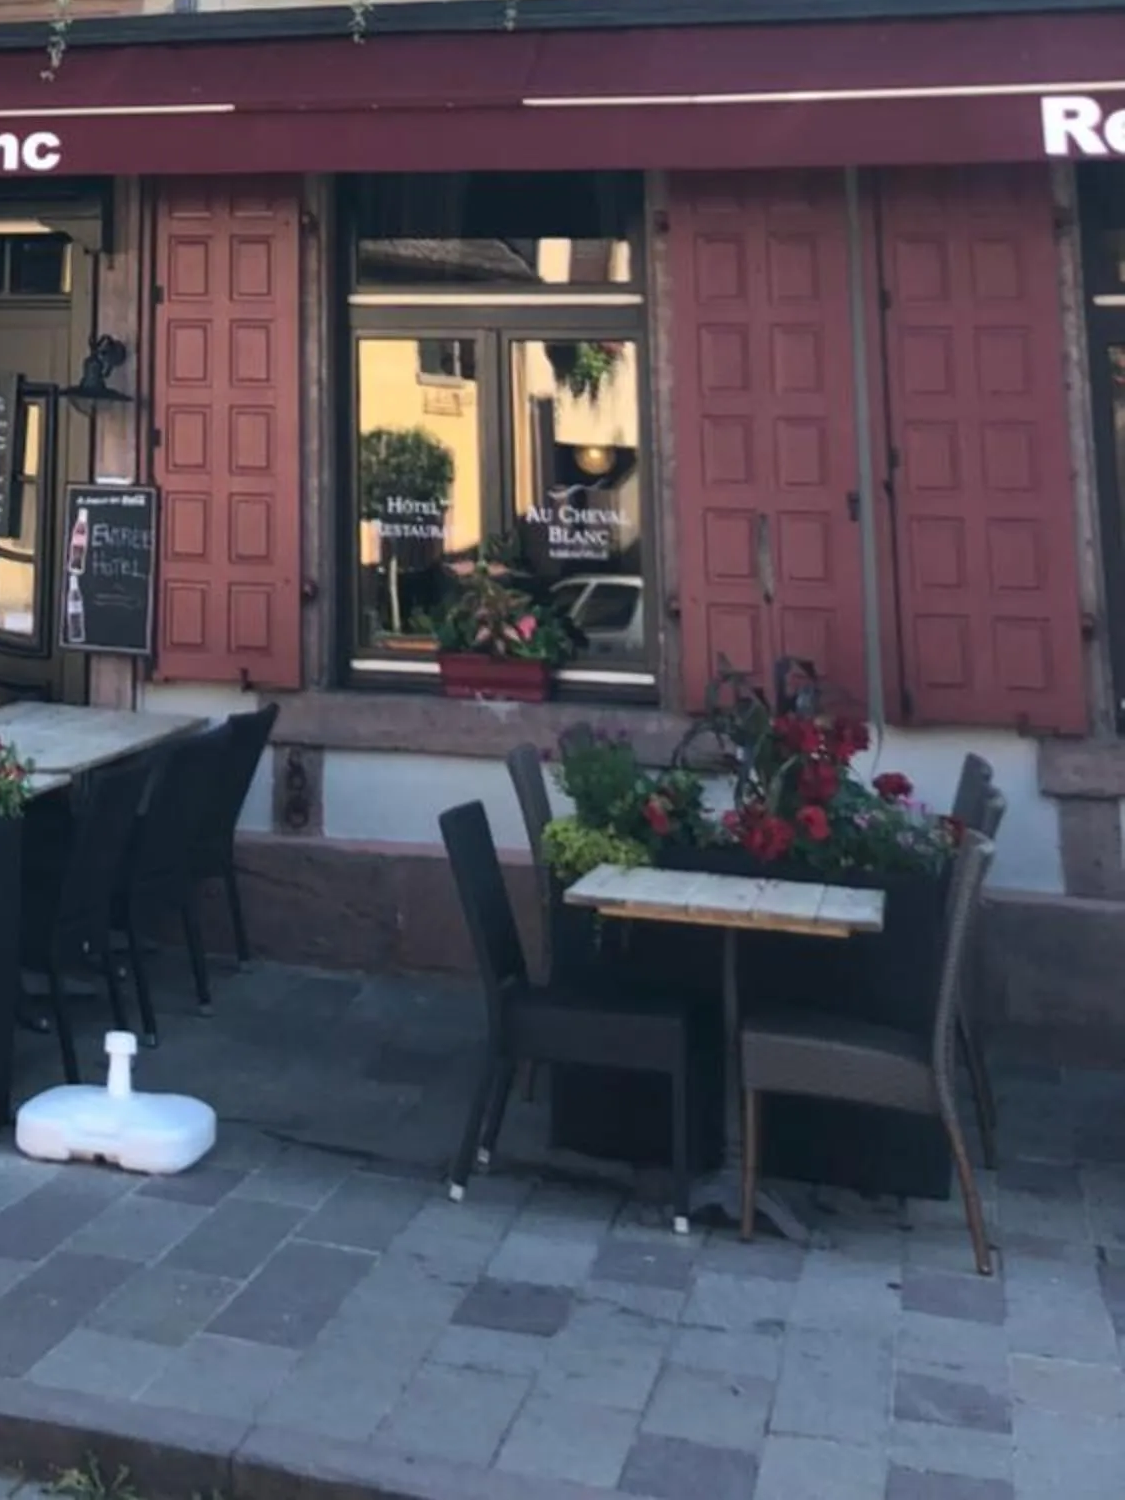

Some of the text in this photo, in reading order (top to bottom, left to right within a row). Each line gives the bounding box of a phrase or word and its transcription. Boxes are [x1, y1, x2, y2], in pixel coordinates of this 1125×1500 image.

[526, 504, 631, 526] AU CHEVAL
[549, 526, 610, 547] BLANC
